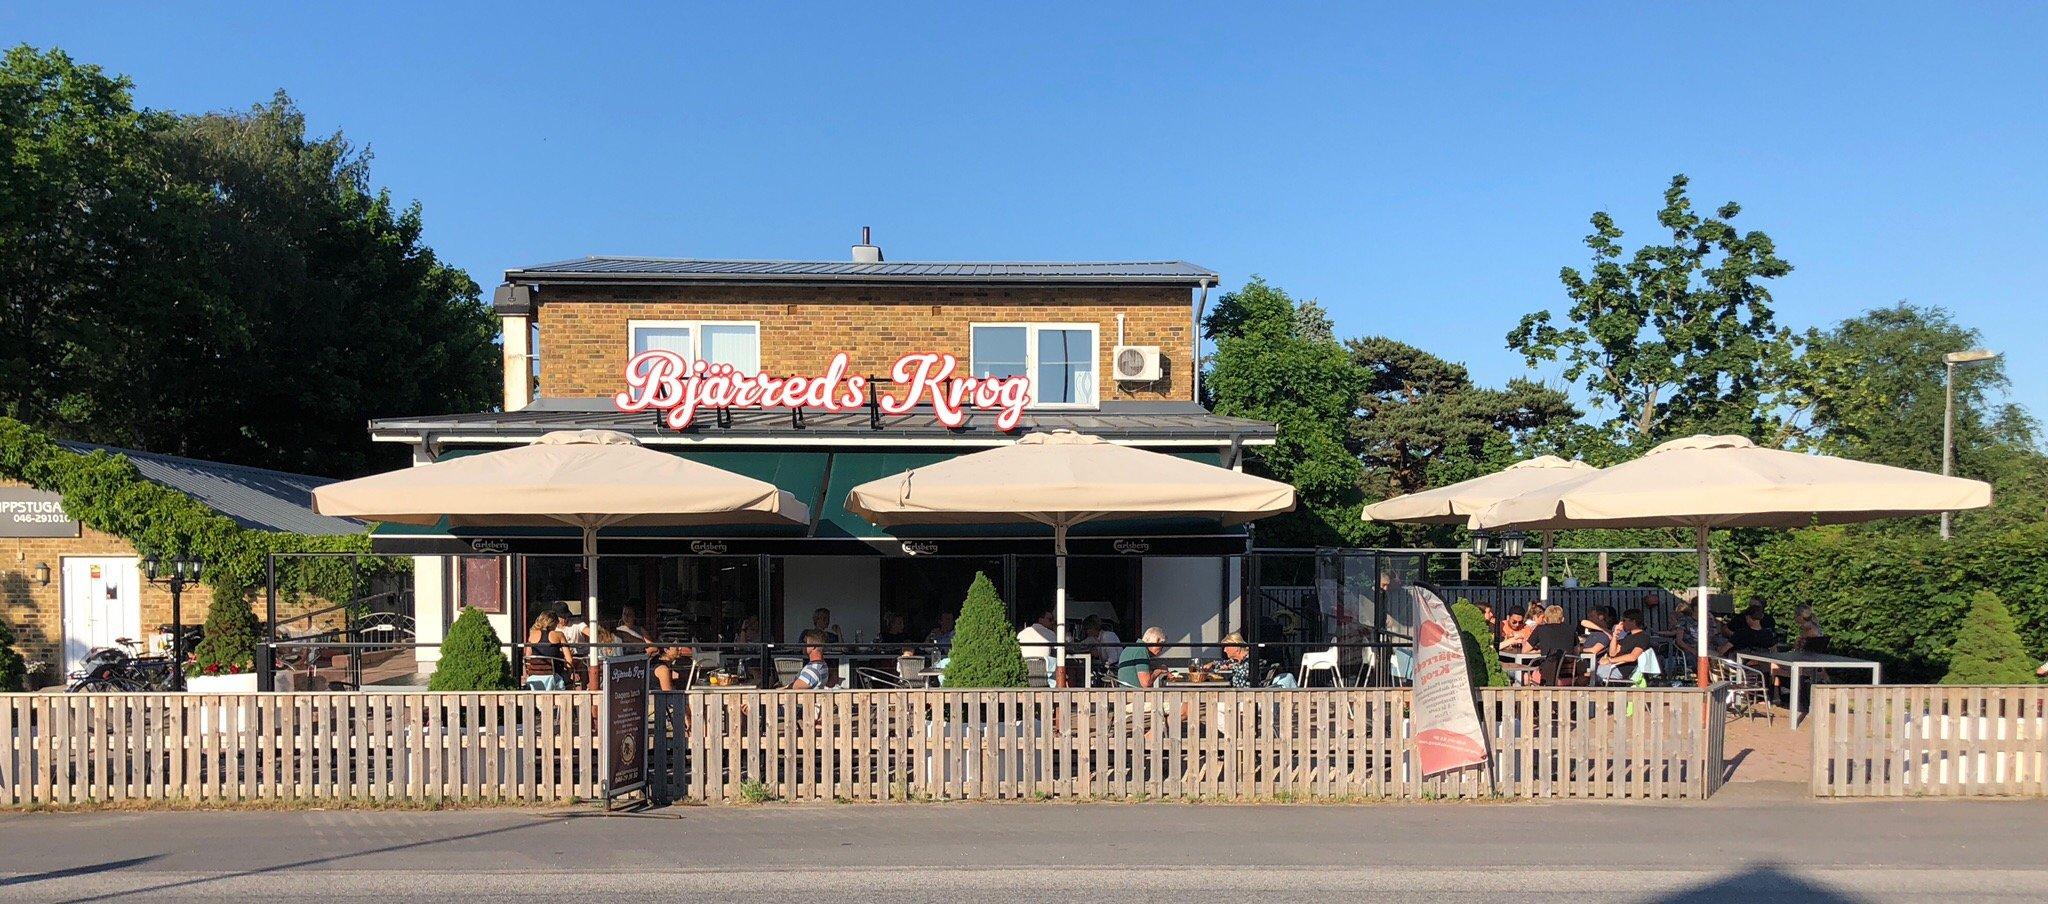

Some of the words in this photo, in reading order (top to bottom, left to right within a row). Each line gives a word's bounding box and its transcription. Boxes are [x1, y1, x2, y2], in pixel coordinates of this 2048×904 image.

[616, 350, 863, 431] Bjärreds
[881, 352, 1031, 431] Krog
[471, 538, 509, 552] Carlsberg
[691, 540, 727, 554] Carlsberg
[901, 540, 938, 555] Carlsberg
[1113, 539, 1149, 553] Carlsberg
